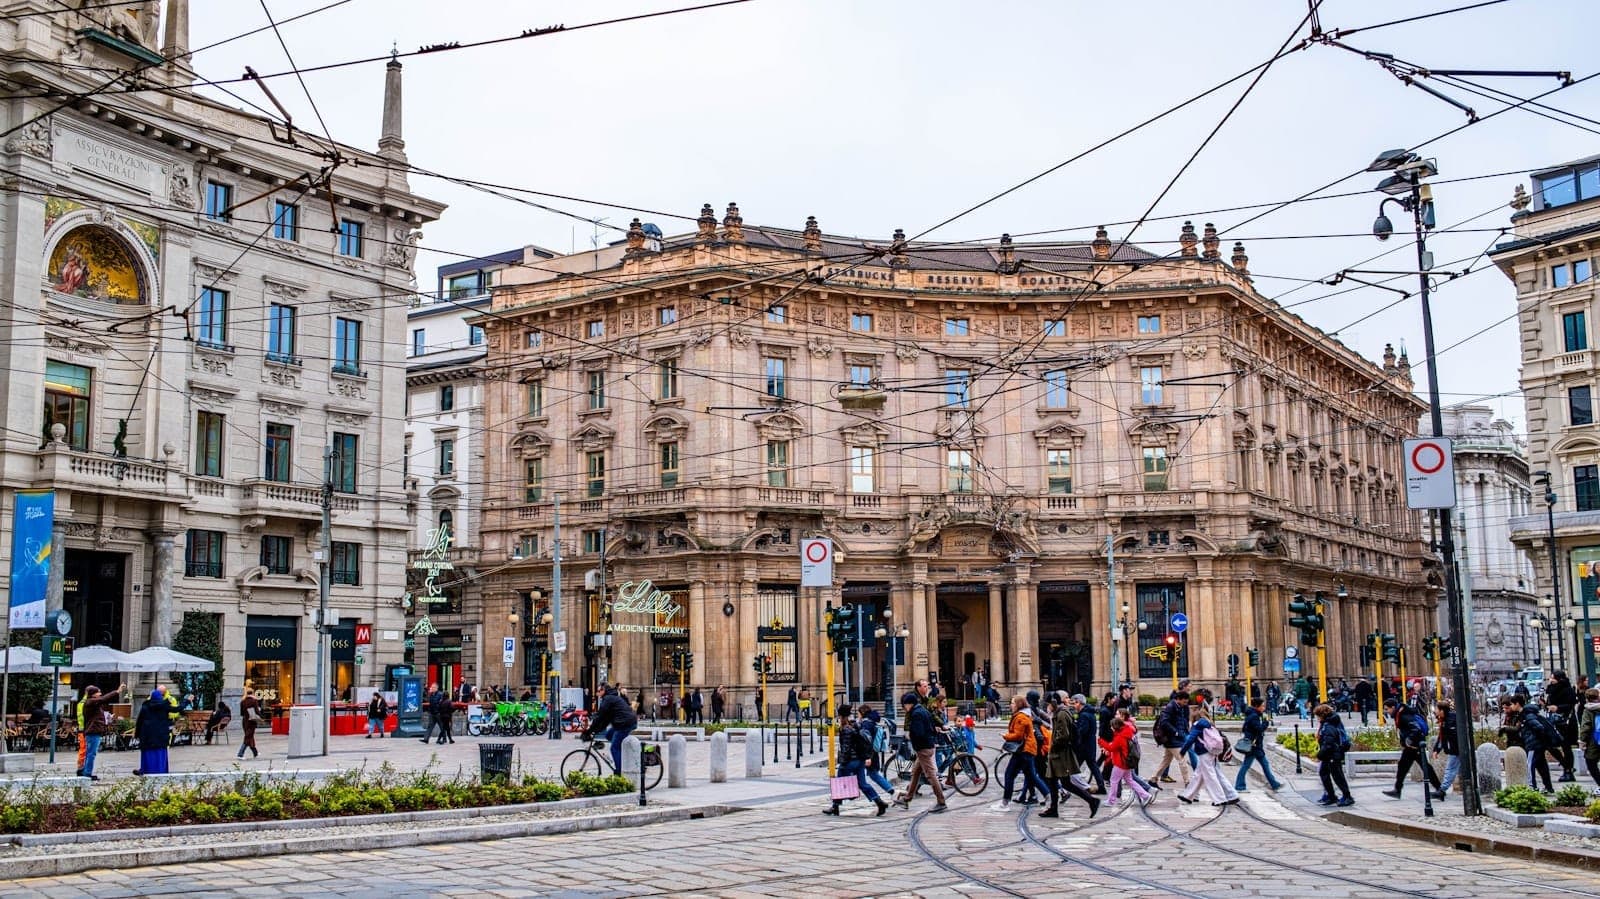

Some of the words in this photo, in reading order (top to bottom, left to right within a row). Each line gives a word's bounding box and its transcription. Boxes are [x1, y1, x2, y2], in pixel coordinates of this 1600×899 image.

[75, 138, 150, 173] ASSICVRAZIONI
[87, 155, 136, 180] GENERALI
[928, 275, 983, 286] RESERVE
[613, 579, 681, 624] Lilly
[357, 628, 370, 641] M
[614, 624, 649, 633] MEDICINE
[650, 626, 684, 634] COMPANY
[257, 638, 282, 648] BOSS
[331, 639, 349, 648] OSS
